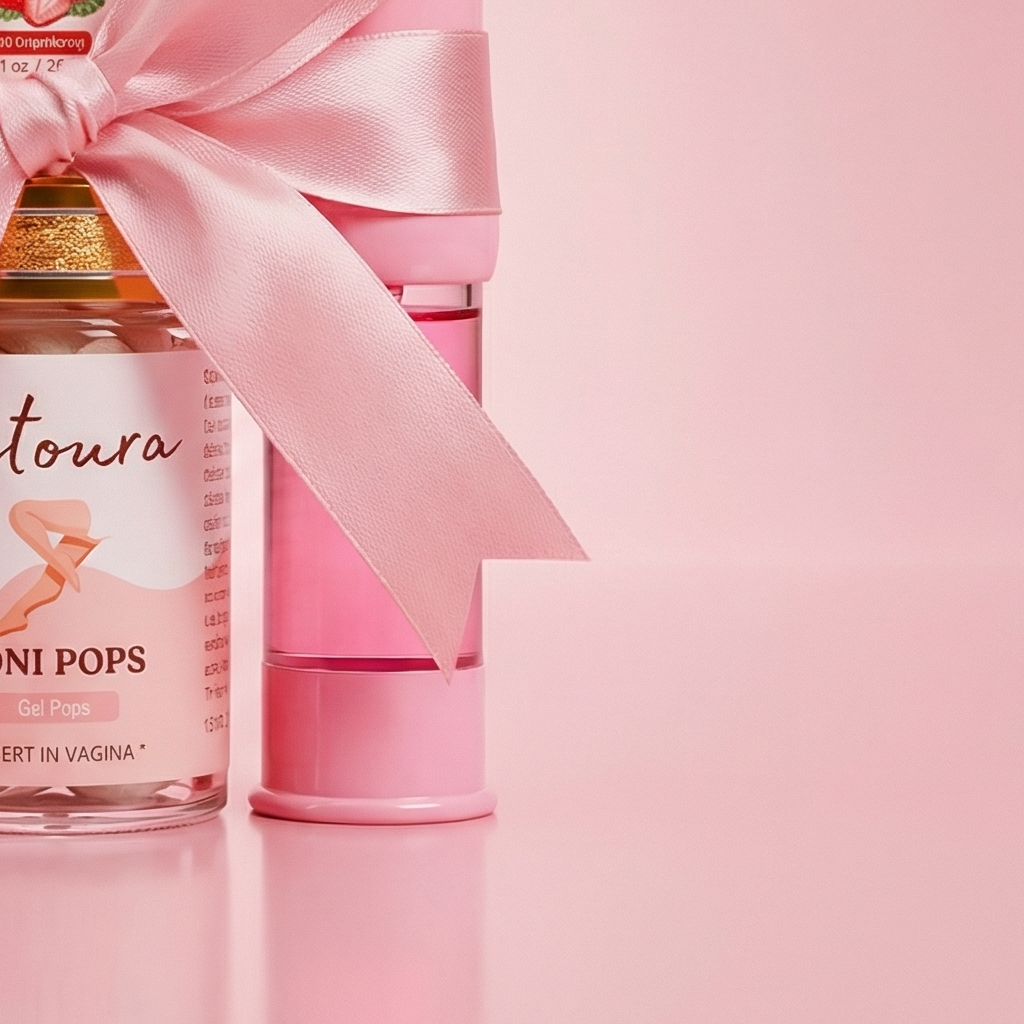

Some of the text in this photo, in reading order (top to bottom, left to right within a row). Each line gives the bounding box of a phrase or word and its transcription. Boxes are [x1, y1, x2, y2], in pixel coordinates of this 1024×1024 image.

[0, 59, 6, 73] 1
[11, 62, 29, 73] oz
[55, 645, 146, 676] POPS
[18, 698, 91, 719] Gel Pops
[40, 746, 59, 763] IN
[65, 744, 135, 763] VAGINA
